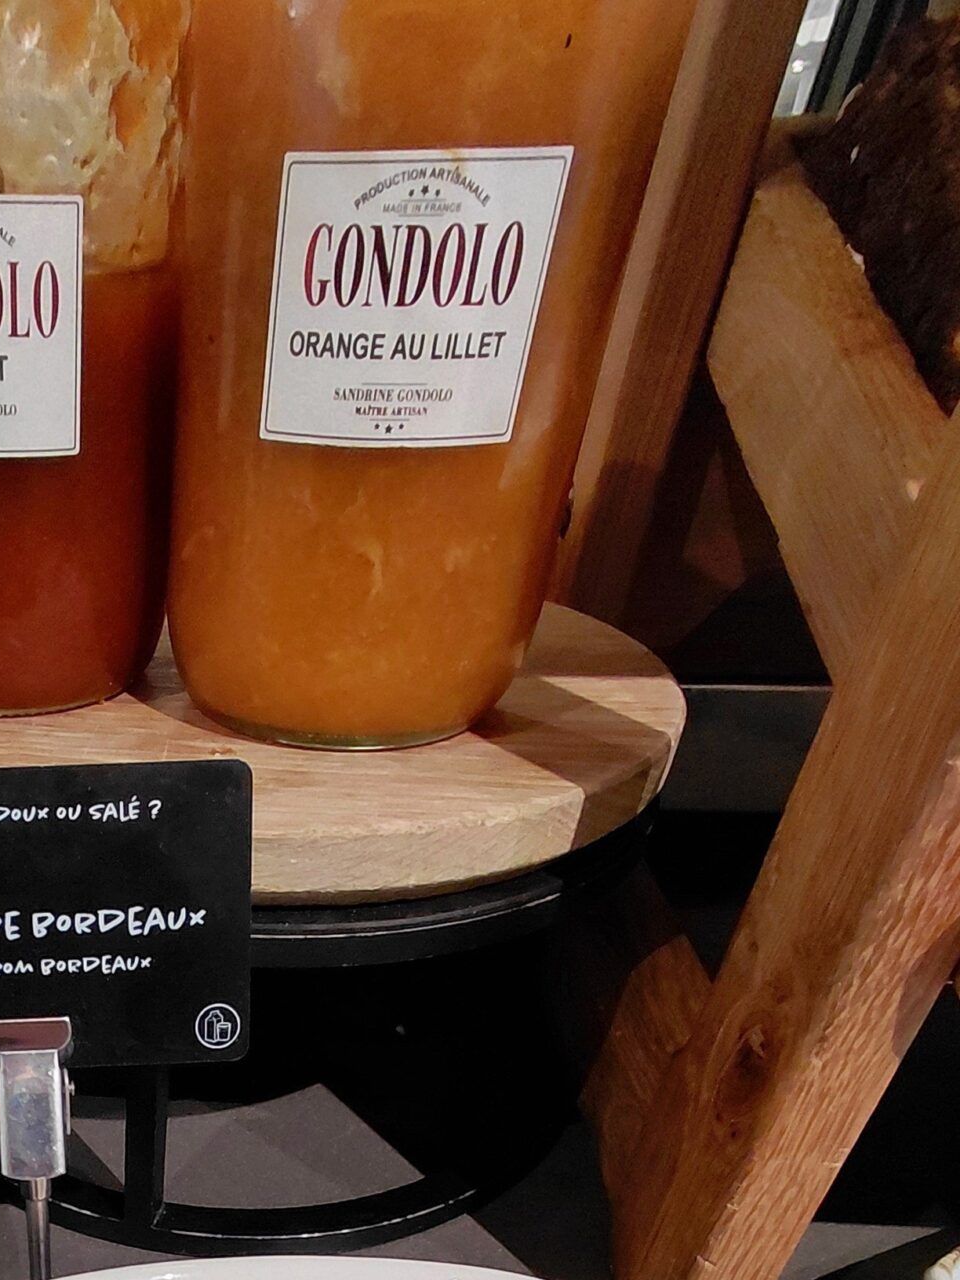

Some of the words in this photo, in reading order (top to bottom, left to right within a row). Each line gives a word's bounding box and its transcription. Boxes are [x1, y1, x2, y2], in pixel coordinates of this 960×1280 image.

[353, 167, 428, 210] PRODUCTION
[429, 166, 491, 207] ARTISANALE
[382, 203, 409, 213] MADE
[411, 203, 421, 213] IN
[424, 202, 462, 213] FRANCE
[303, 220, 524, 308] GONDOLO
[290, 330, 386, 360] ORANGE
[390, 332, 426, 360] AU
[431, 331, 507, 359] LILLET
[333, 387, 394, 402] SANDRINE
[396, 388, 453, 402] GONDOLO
[391, 406, 428, 416] ARTISAN
[55, 804, 81, 821] OU
[88, 795, 141, 821] SALÉ
[31, 906, 207, 939] BORDEAUX
[40, 956, 152, 976] BORDEAUX
